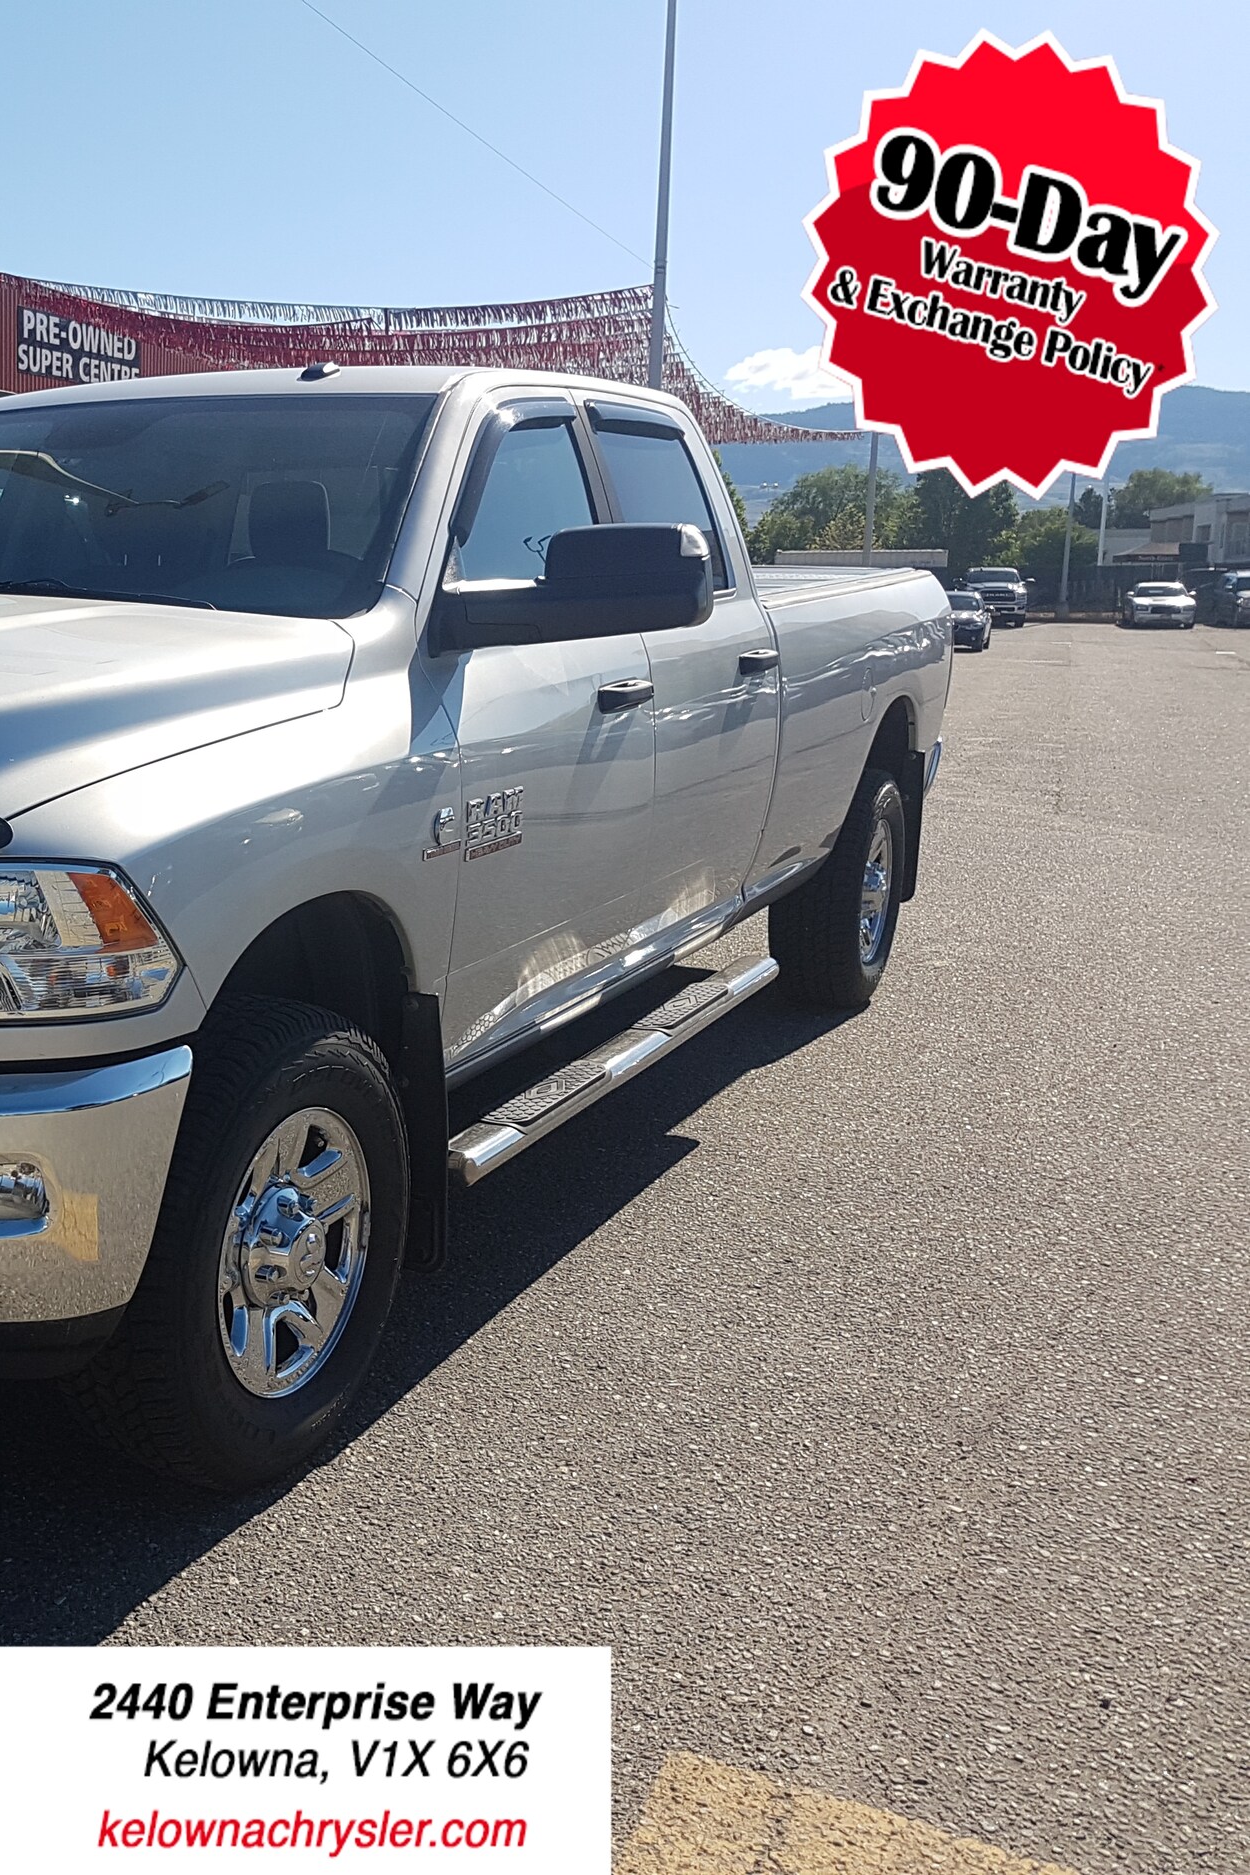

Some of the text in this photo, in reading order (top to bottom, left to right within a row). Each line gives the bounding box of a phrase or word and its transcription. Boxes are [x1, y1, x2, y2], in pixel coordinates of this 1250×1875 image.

[22, 308, 137, 361] PRE-OWNED
[17, 343, 141, 383] SUPER CENTRE
[466, 786, 524, 823] RAM
